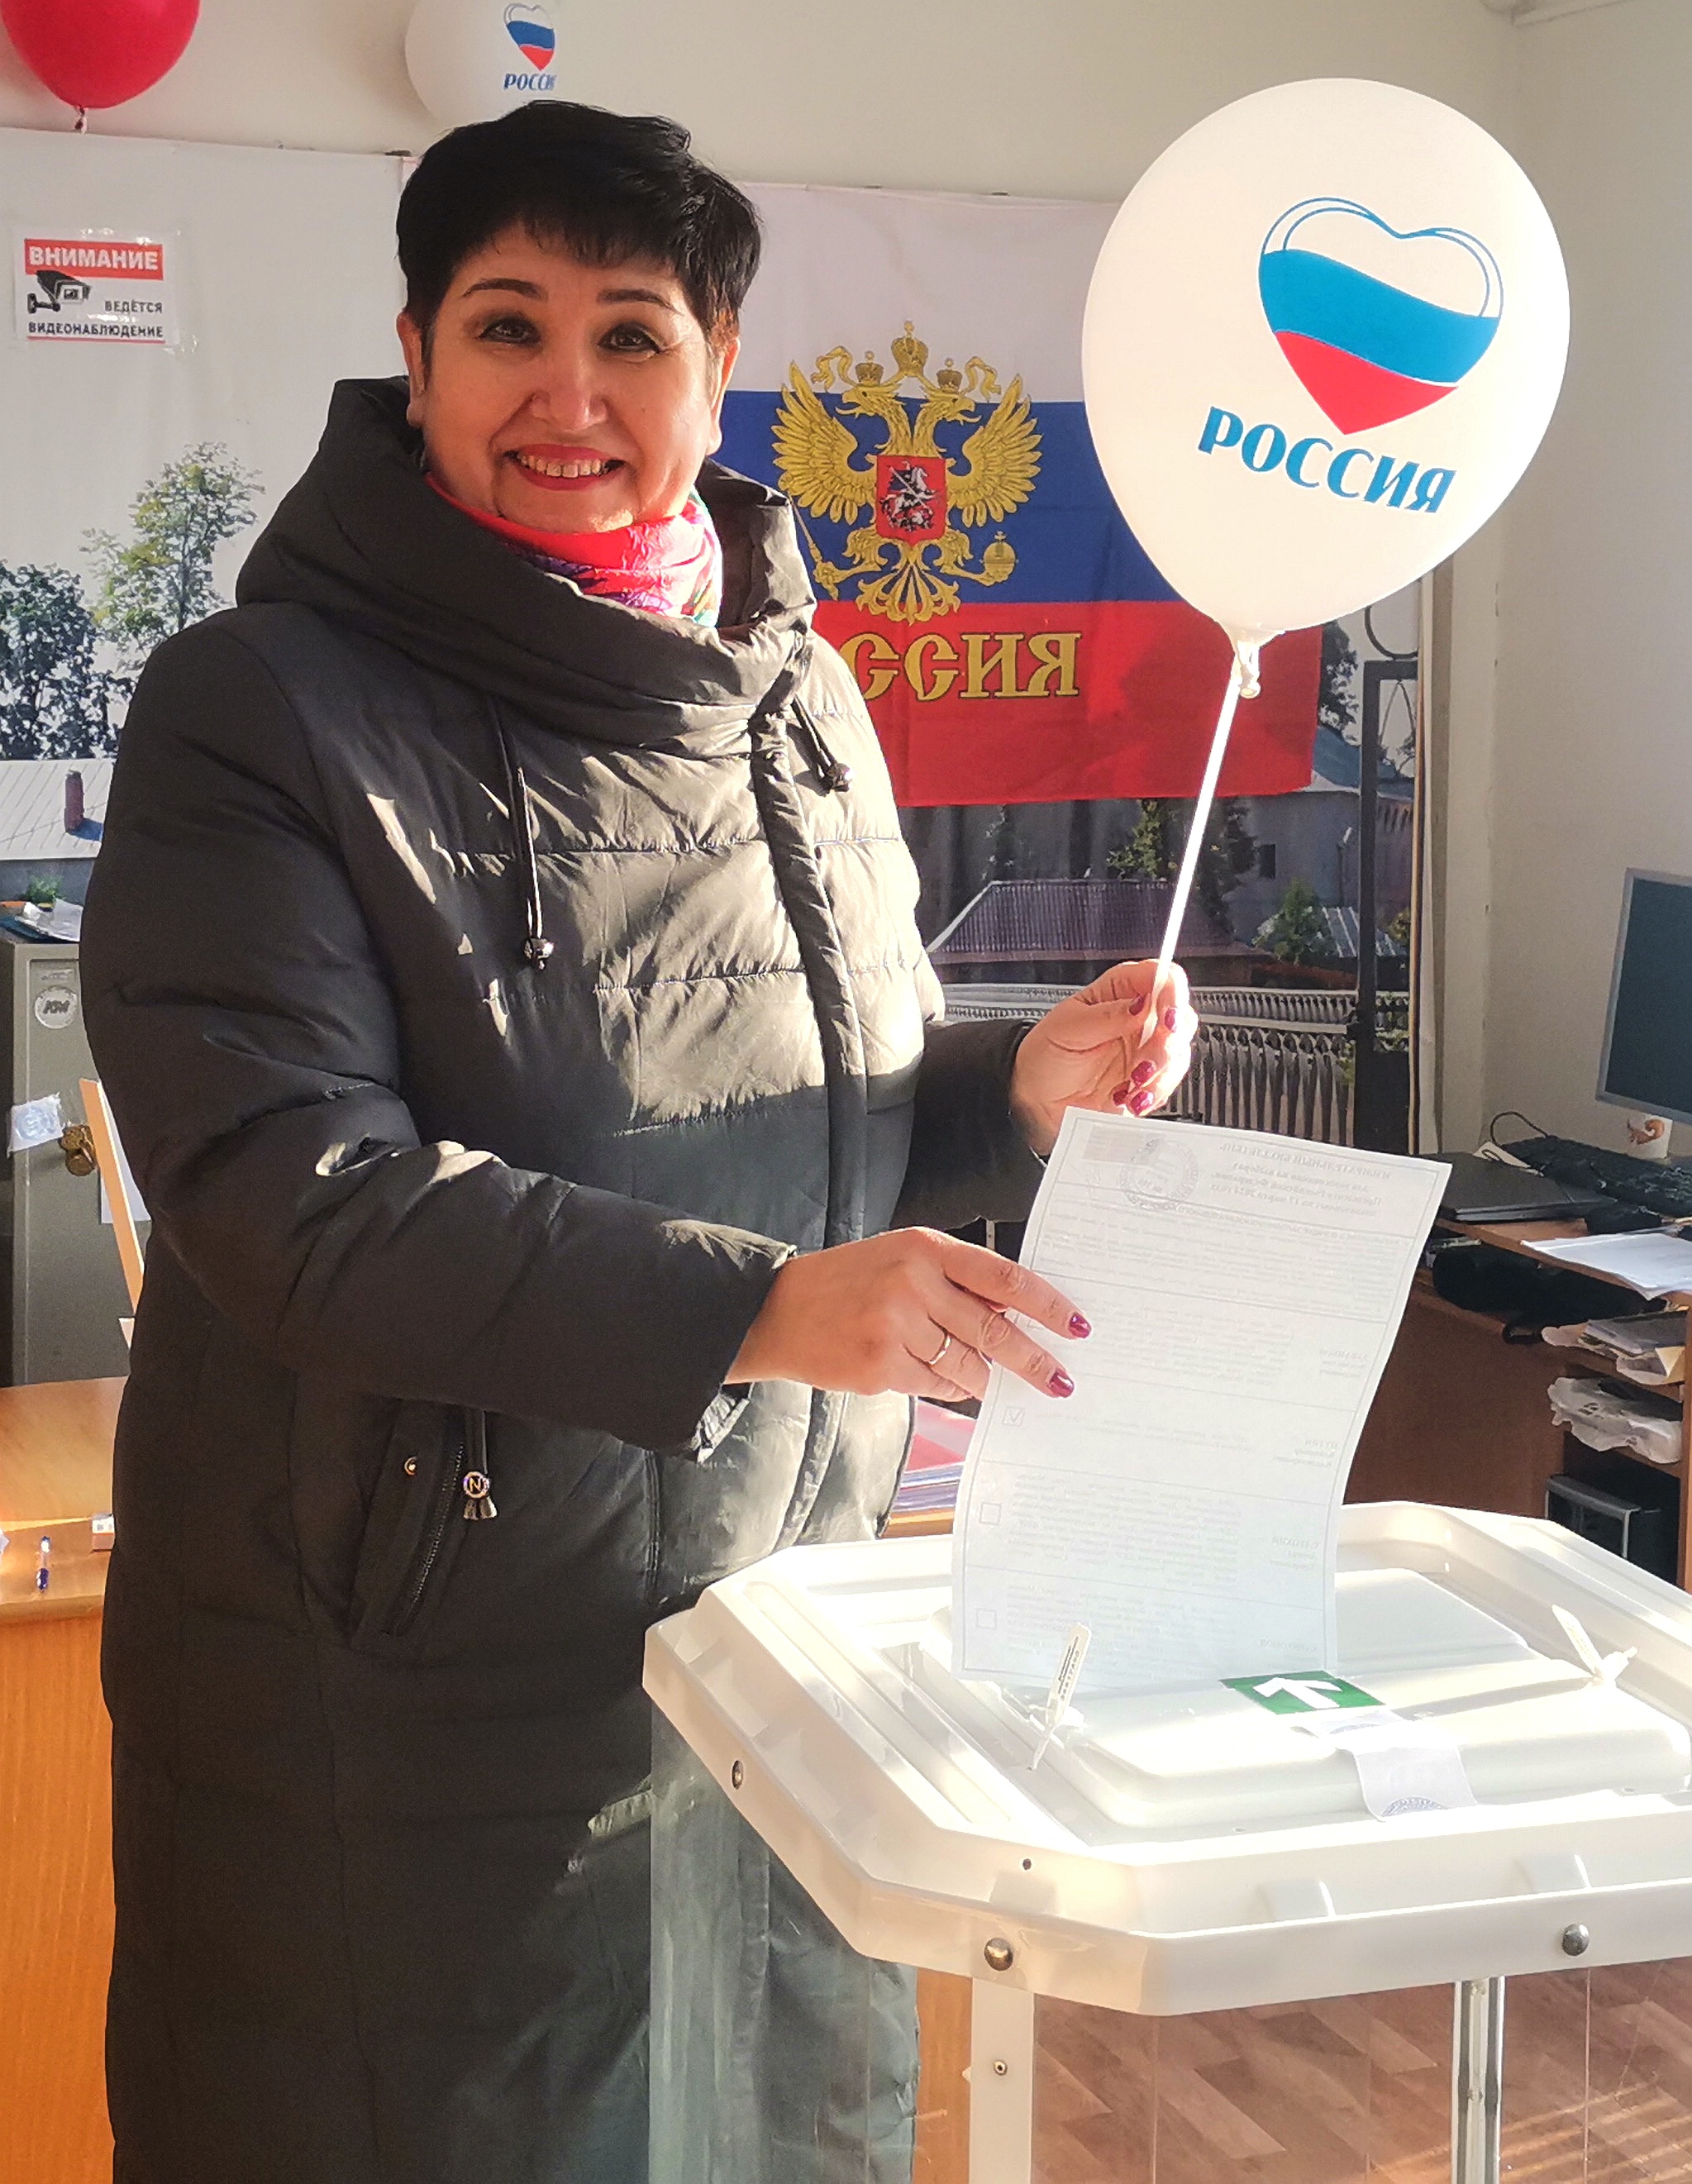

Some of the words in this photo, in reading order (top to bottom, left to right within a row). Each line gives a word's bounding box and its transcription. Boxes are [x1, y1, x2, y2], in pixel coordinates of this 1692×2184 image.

[29, 246, 159, 270] ВНИМАНИЕ
[28, 322, 164, 338] ВИДЕОНАБЛЮДЕНИЕ
[1198, 405, 1457, 513] РОССИЯ
